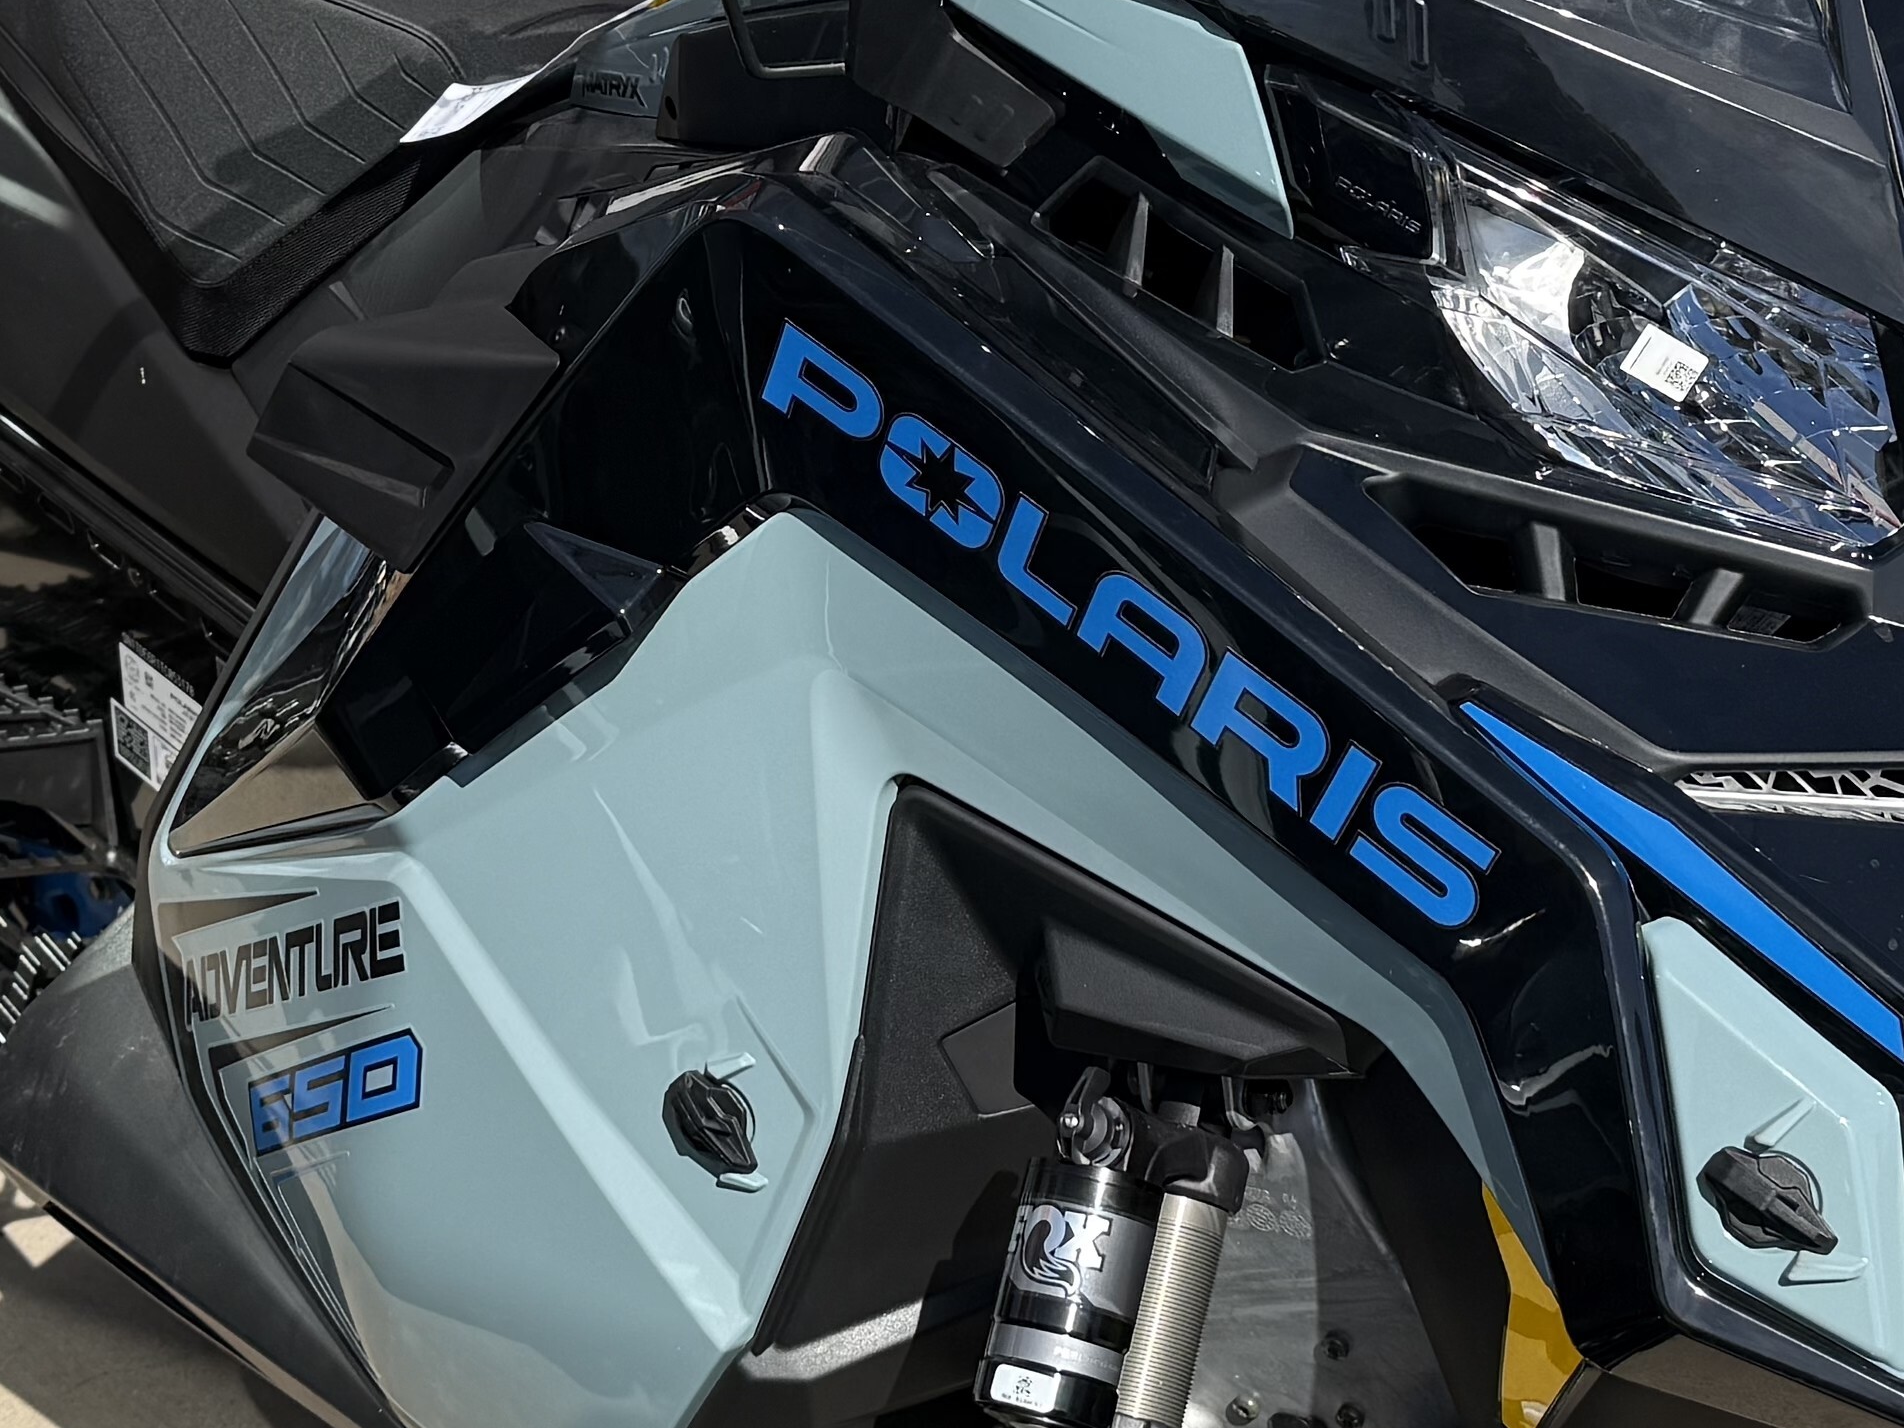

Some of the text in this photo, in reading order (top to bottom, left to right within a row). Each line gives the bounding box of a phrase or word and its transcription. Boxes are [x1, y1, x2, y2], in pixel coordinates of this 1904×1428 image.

[574, 70, 649, 109] MATRYX
[1335, 174, 1423, 235] POLARIS
[761, 318, 1502, 929] POLARIS
[182, 898, 406, 1025] ADVENTURE
[248, 1027, 423, 1157] 650
